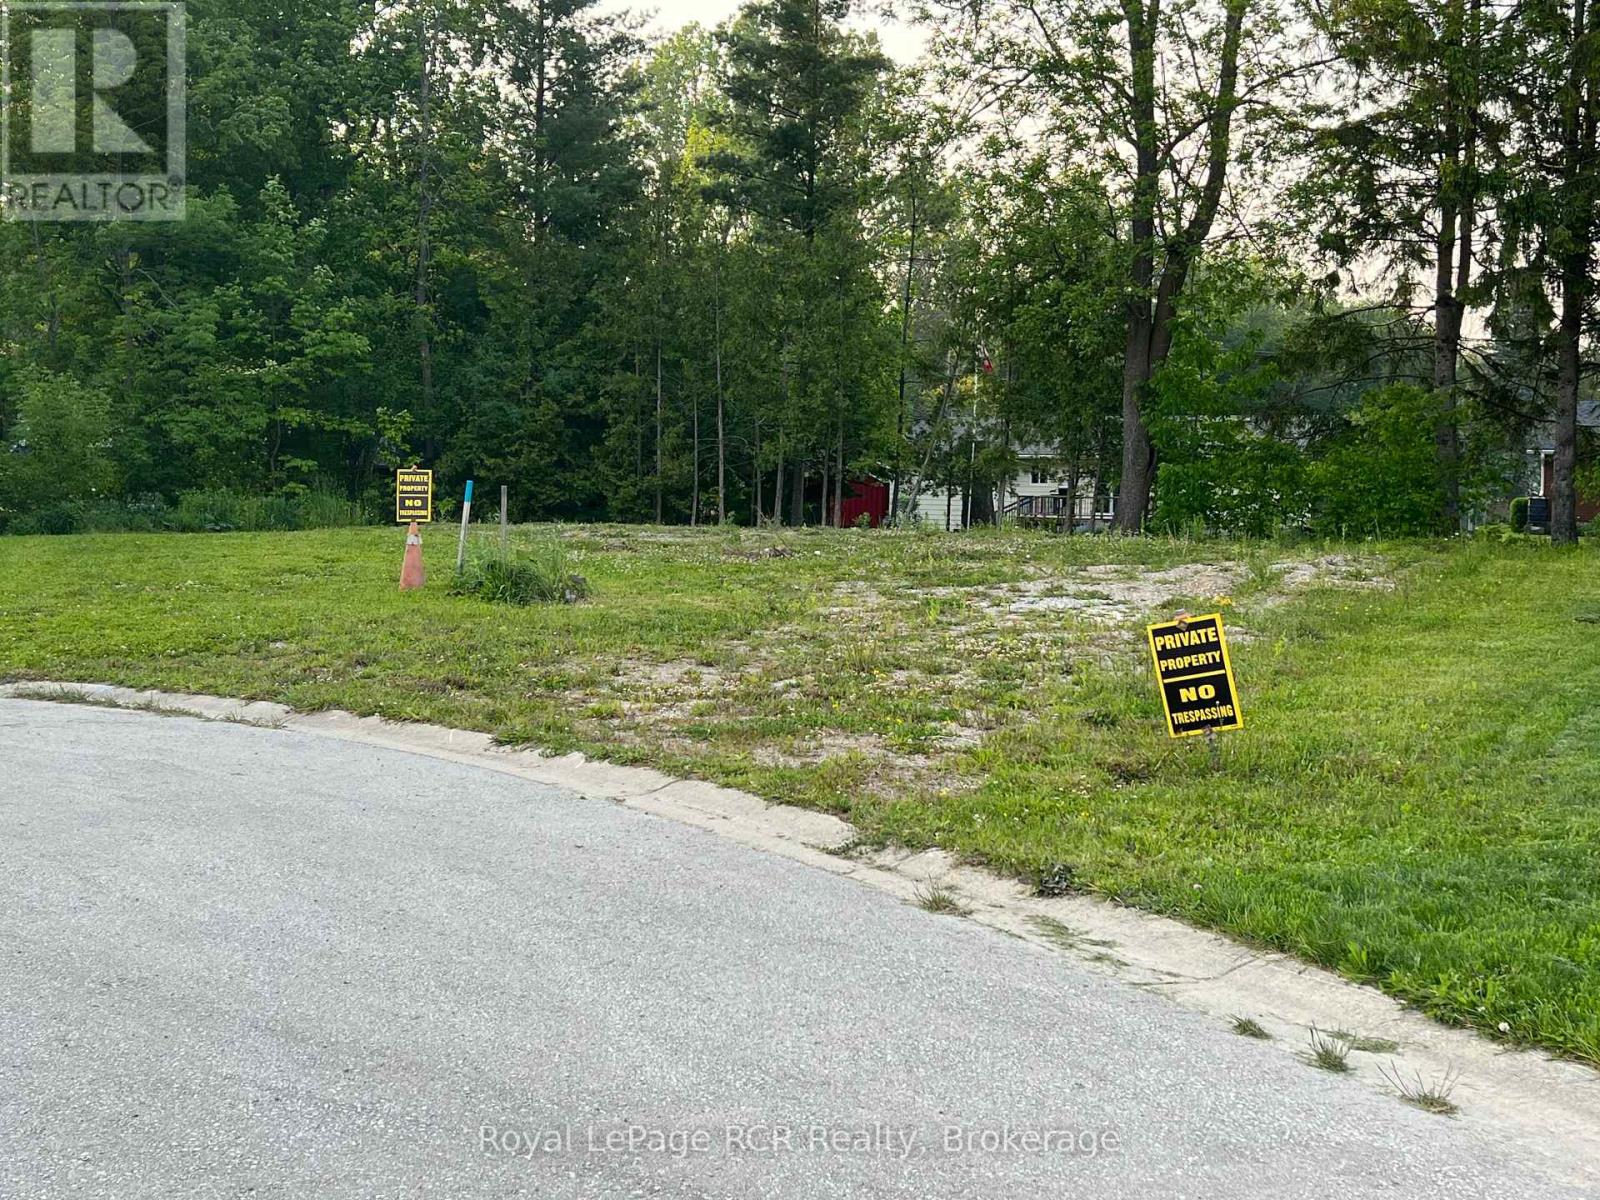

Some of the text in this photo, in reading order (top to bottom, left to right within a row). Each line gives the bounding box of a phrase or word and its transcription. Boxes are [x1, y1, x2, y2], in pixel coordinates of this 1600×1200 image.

[1154, 627, 1218, 651] PRIVATE
[1160, 651, 1220, 671] PROPERTY
[1179, 684, 1216, 703] NO
[1171, 704, 1234, 725] TRESPASSING
